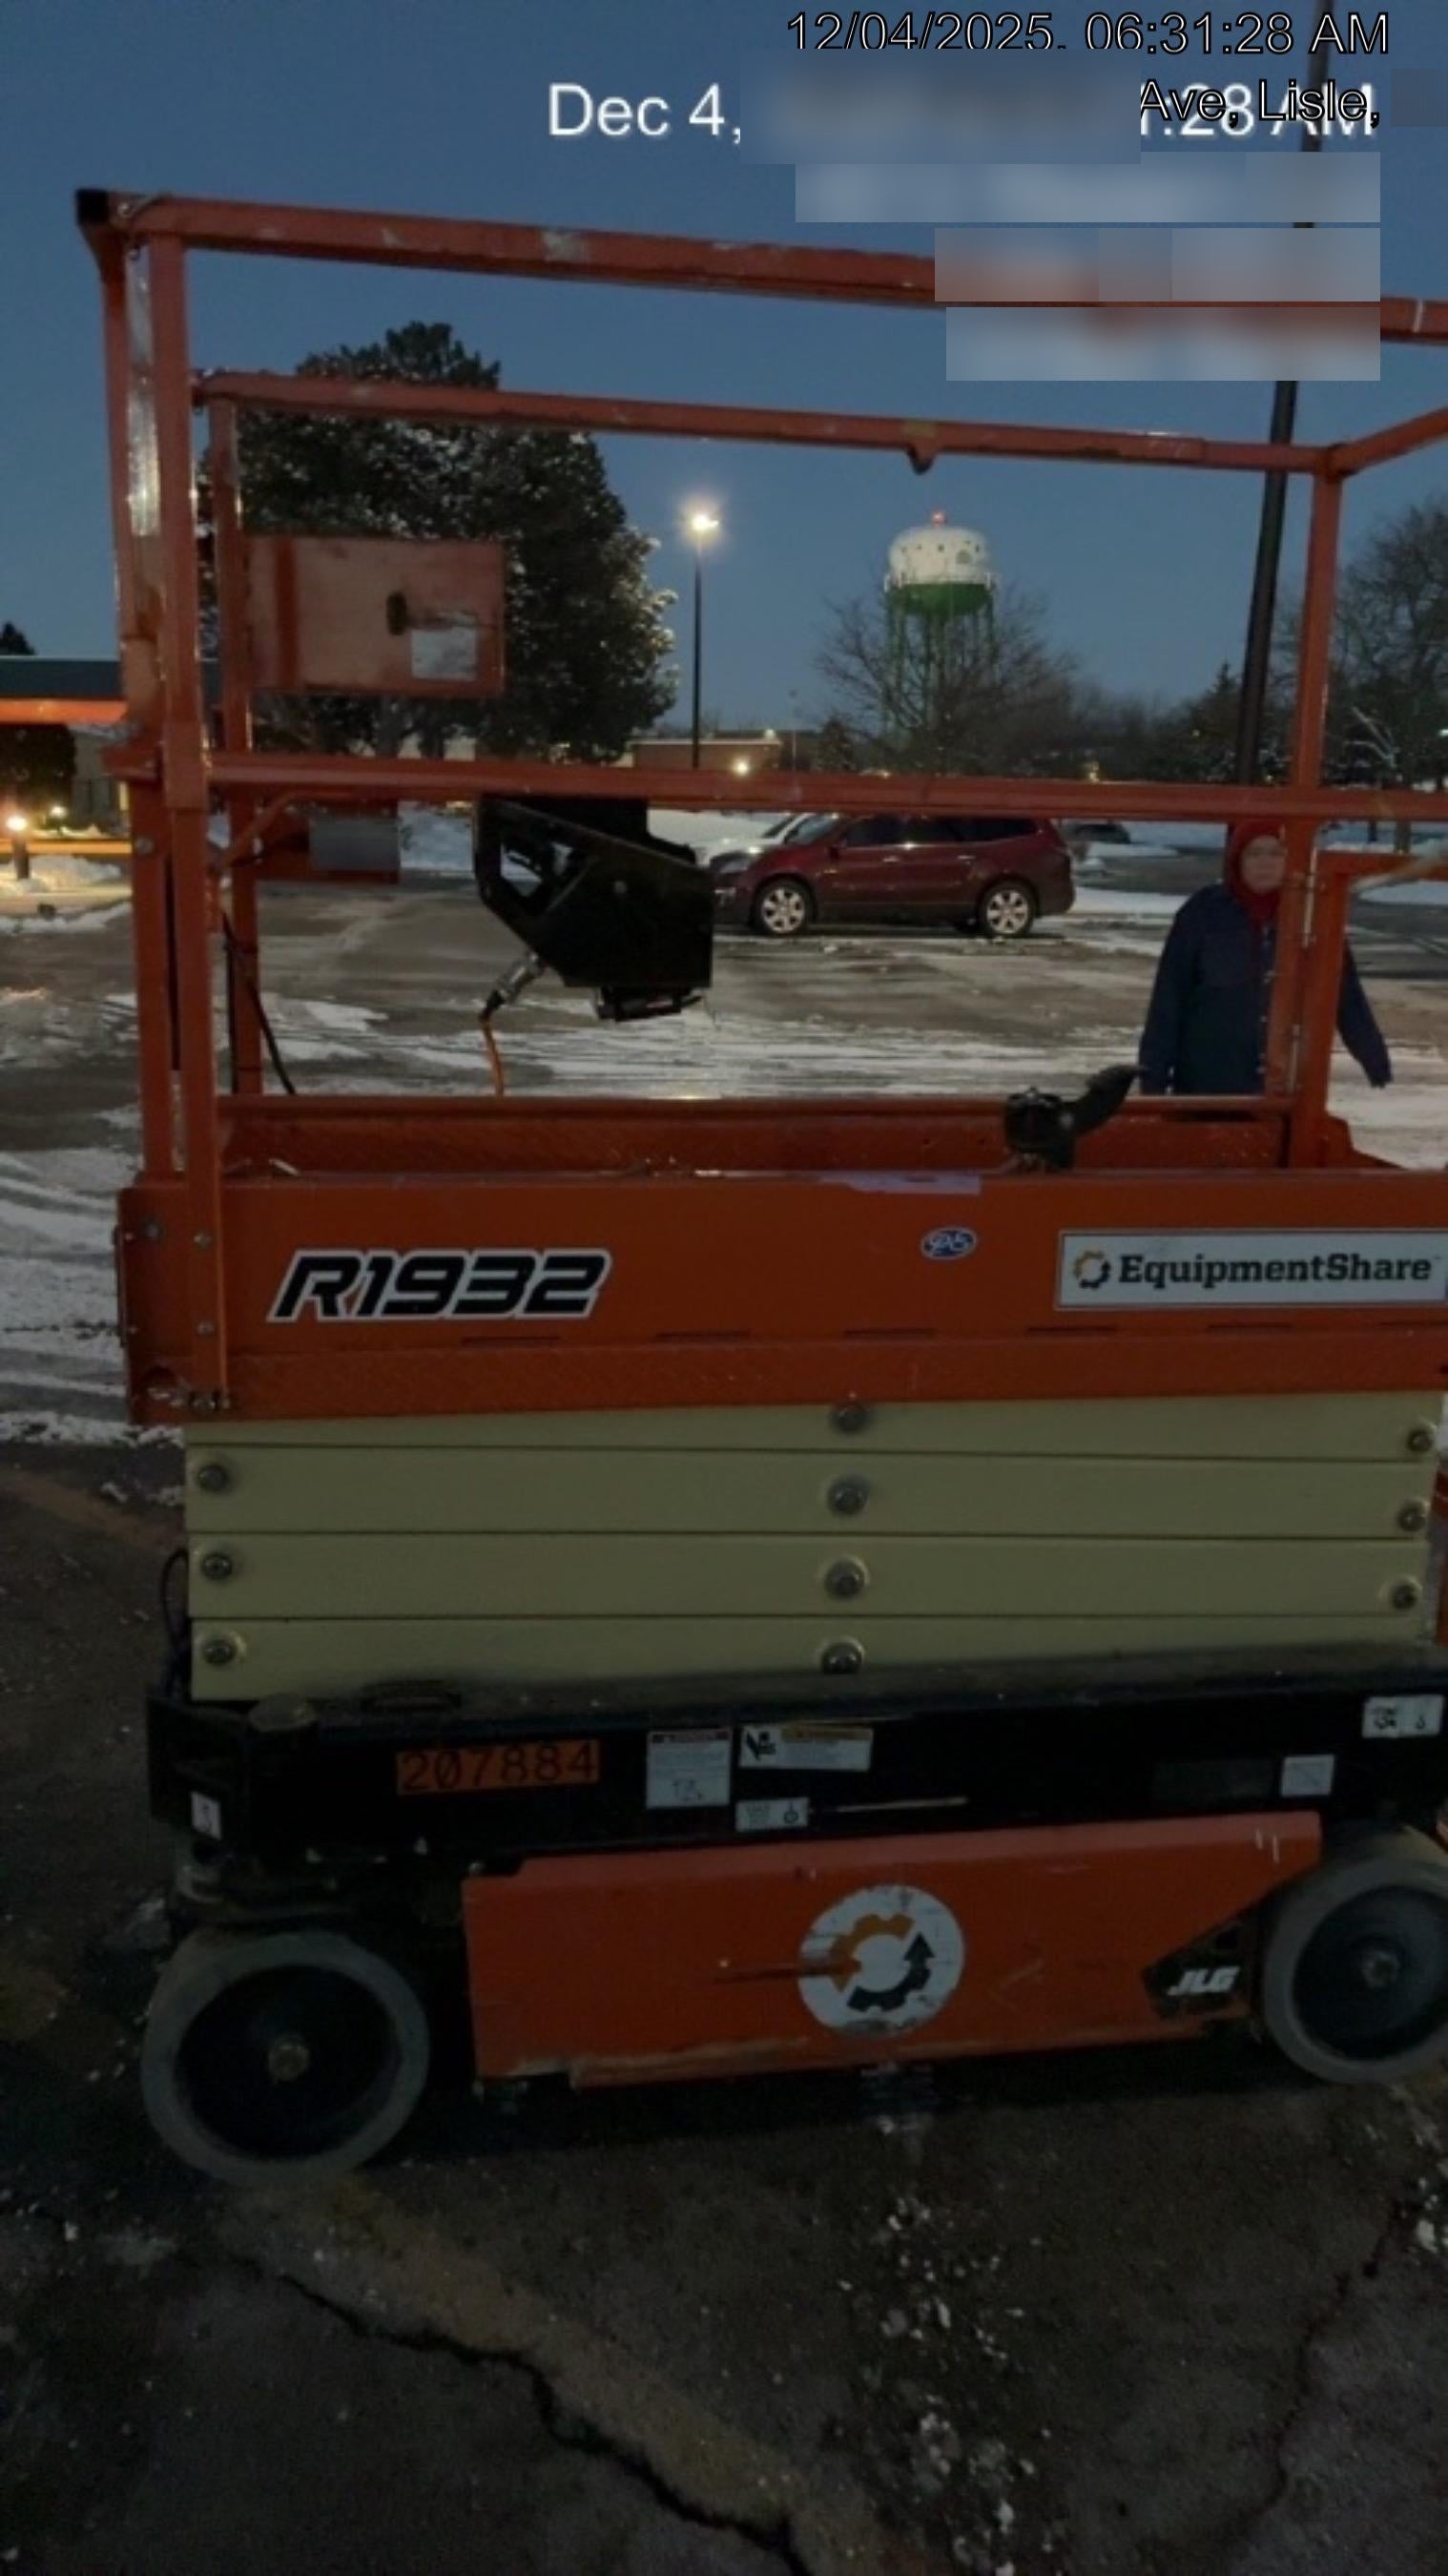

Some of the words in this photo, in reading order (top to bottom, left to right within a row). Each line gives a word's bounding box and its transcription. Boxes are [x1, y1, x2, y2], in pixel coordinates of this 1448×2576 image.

[266, 1248, 612, 1322] R1932
[1118, 1253, 1432, 1290] EquipmentShare
[402, 1741, 596, 1791] 207884
[1167, 1966, 1239, 1996] JLG
